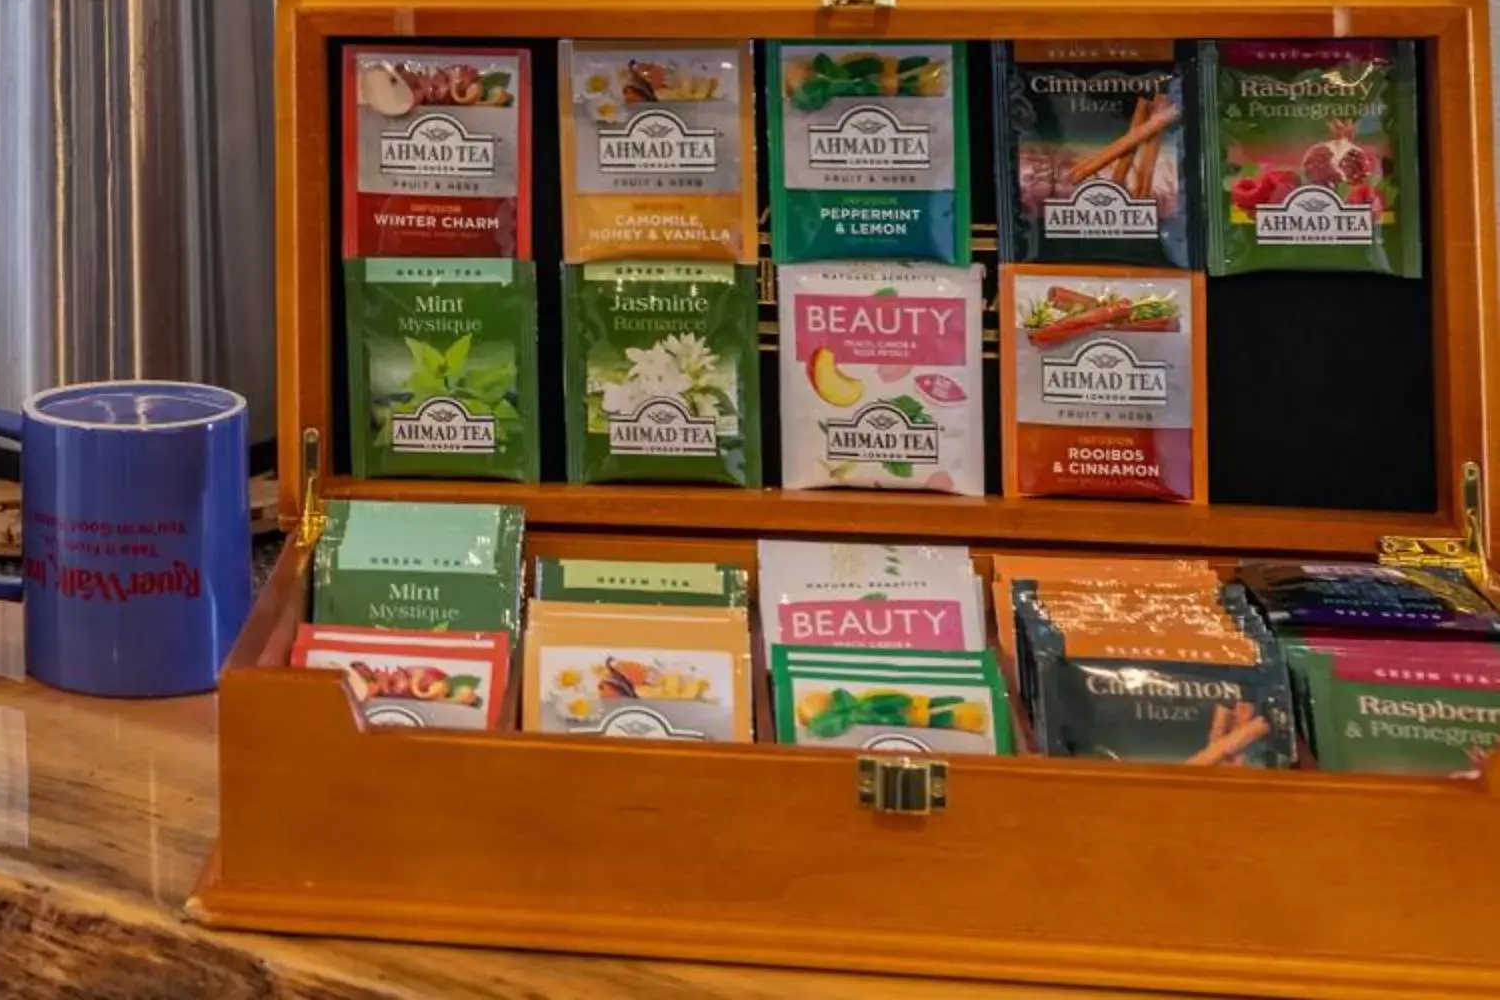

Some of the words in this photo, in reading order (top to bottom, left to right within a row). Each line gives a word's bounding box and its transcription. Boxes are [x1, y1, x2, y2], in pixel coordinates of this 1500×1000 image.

[1031, 75, 1159, 93] Cinnamon
[1240, 79, 1374, 100] Raspberry
[1070, 98, 1123, 114] Haze
[1226, 104, 1242, 118] &
[1250, 102, 1388, 120] Pomegranate
[384, 144, 454, 163] AHMAD
[455, 146, 490, 163] TEA
[602, 141, 674, 159] AHMAD
[675, 141, 712, 159] TEA
[814, 137, 886, 155] AHMAD
[889, 137, 925, 155] TEA
[374, 214, 436, 228] WINTER
[441, 216, 499, 229] CHARM
[615, 215, 703, 228] CAMOMILE,
[820, 208, 921, 221] PEPPERMINT
[1048, 209, 1118, 226] AHMAD
[1119, 210, 1154, 226] TEA
[1260, 215, 1331, 231] AHMAD
[1333, 215, 1369, 231] TEA
[589, 229, 642, 241] HONEY
[646, 230, 659, 241] &
[663, 229, 730, 242] VANILLA
[835, 224, 845, 234] &
[851, 223, 908, 235] LEMON
[415, 296, 464, 313] Mint
[609, 295, 709, 313] Jasmine
[398, 317, 483, 334] Mystique
[613, 316, 708, 332] Romance
[806, 305, 953, 336] BEAUTY
[1047, 371, 1123, 390] AHMAD
[1127, 373, 1163, 391] TEA
[395, 425, 457, 440] AHMAD
[459, 426, 492, 441] TEA
[613, 426, 677, 442] AHMAD
[679, 427, 714, 443] TEA
[830, 432, 897, 450] AHMAD
[899, 434, 934, 451] TEA
[1068, 447, 1145, 462] ROOIBOS
[1053, 462, 1063, 473] &
[1069, 462, 1160, 477] CINNAMON
[389, 583, 440, 601] Mint
[369, 603, 459, 623] Mystique
[791, 609, 947, 639] BEAUTY
[1373, 668, 1442, 681] GREEN
[1452, 672, 1491, 685] TEA
[1135, 703, 1199, 721] Haze
[1345, 721, 1363, 738] &
